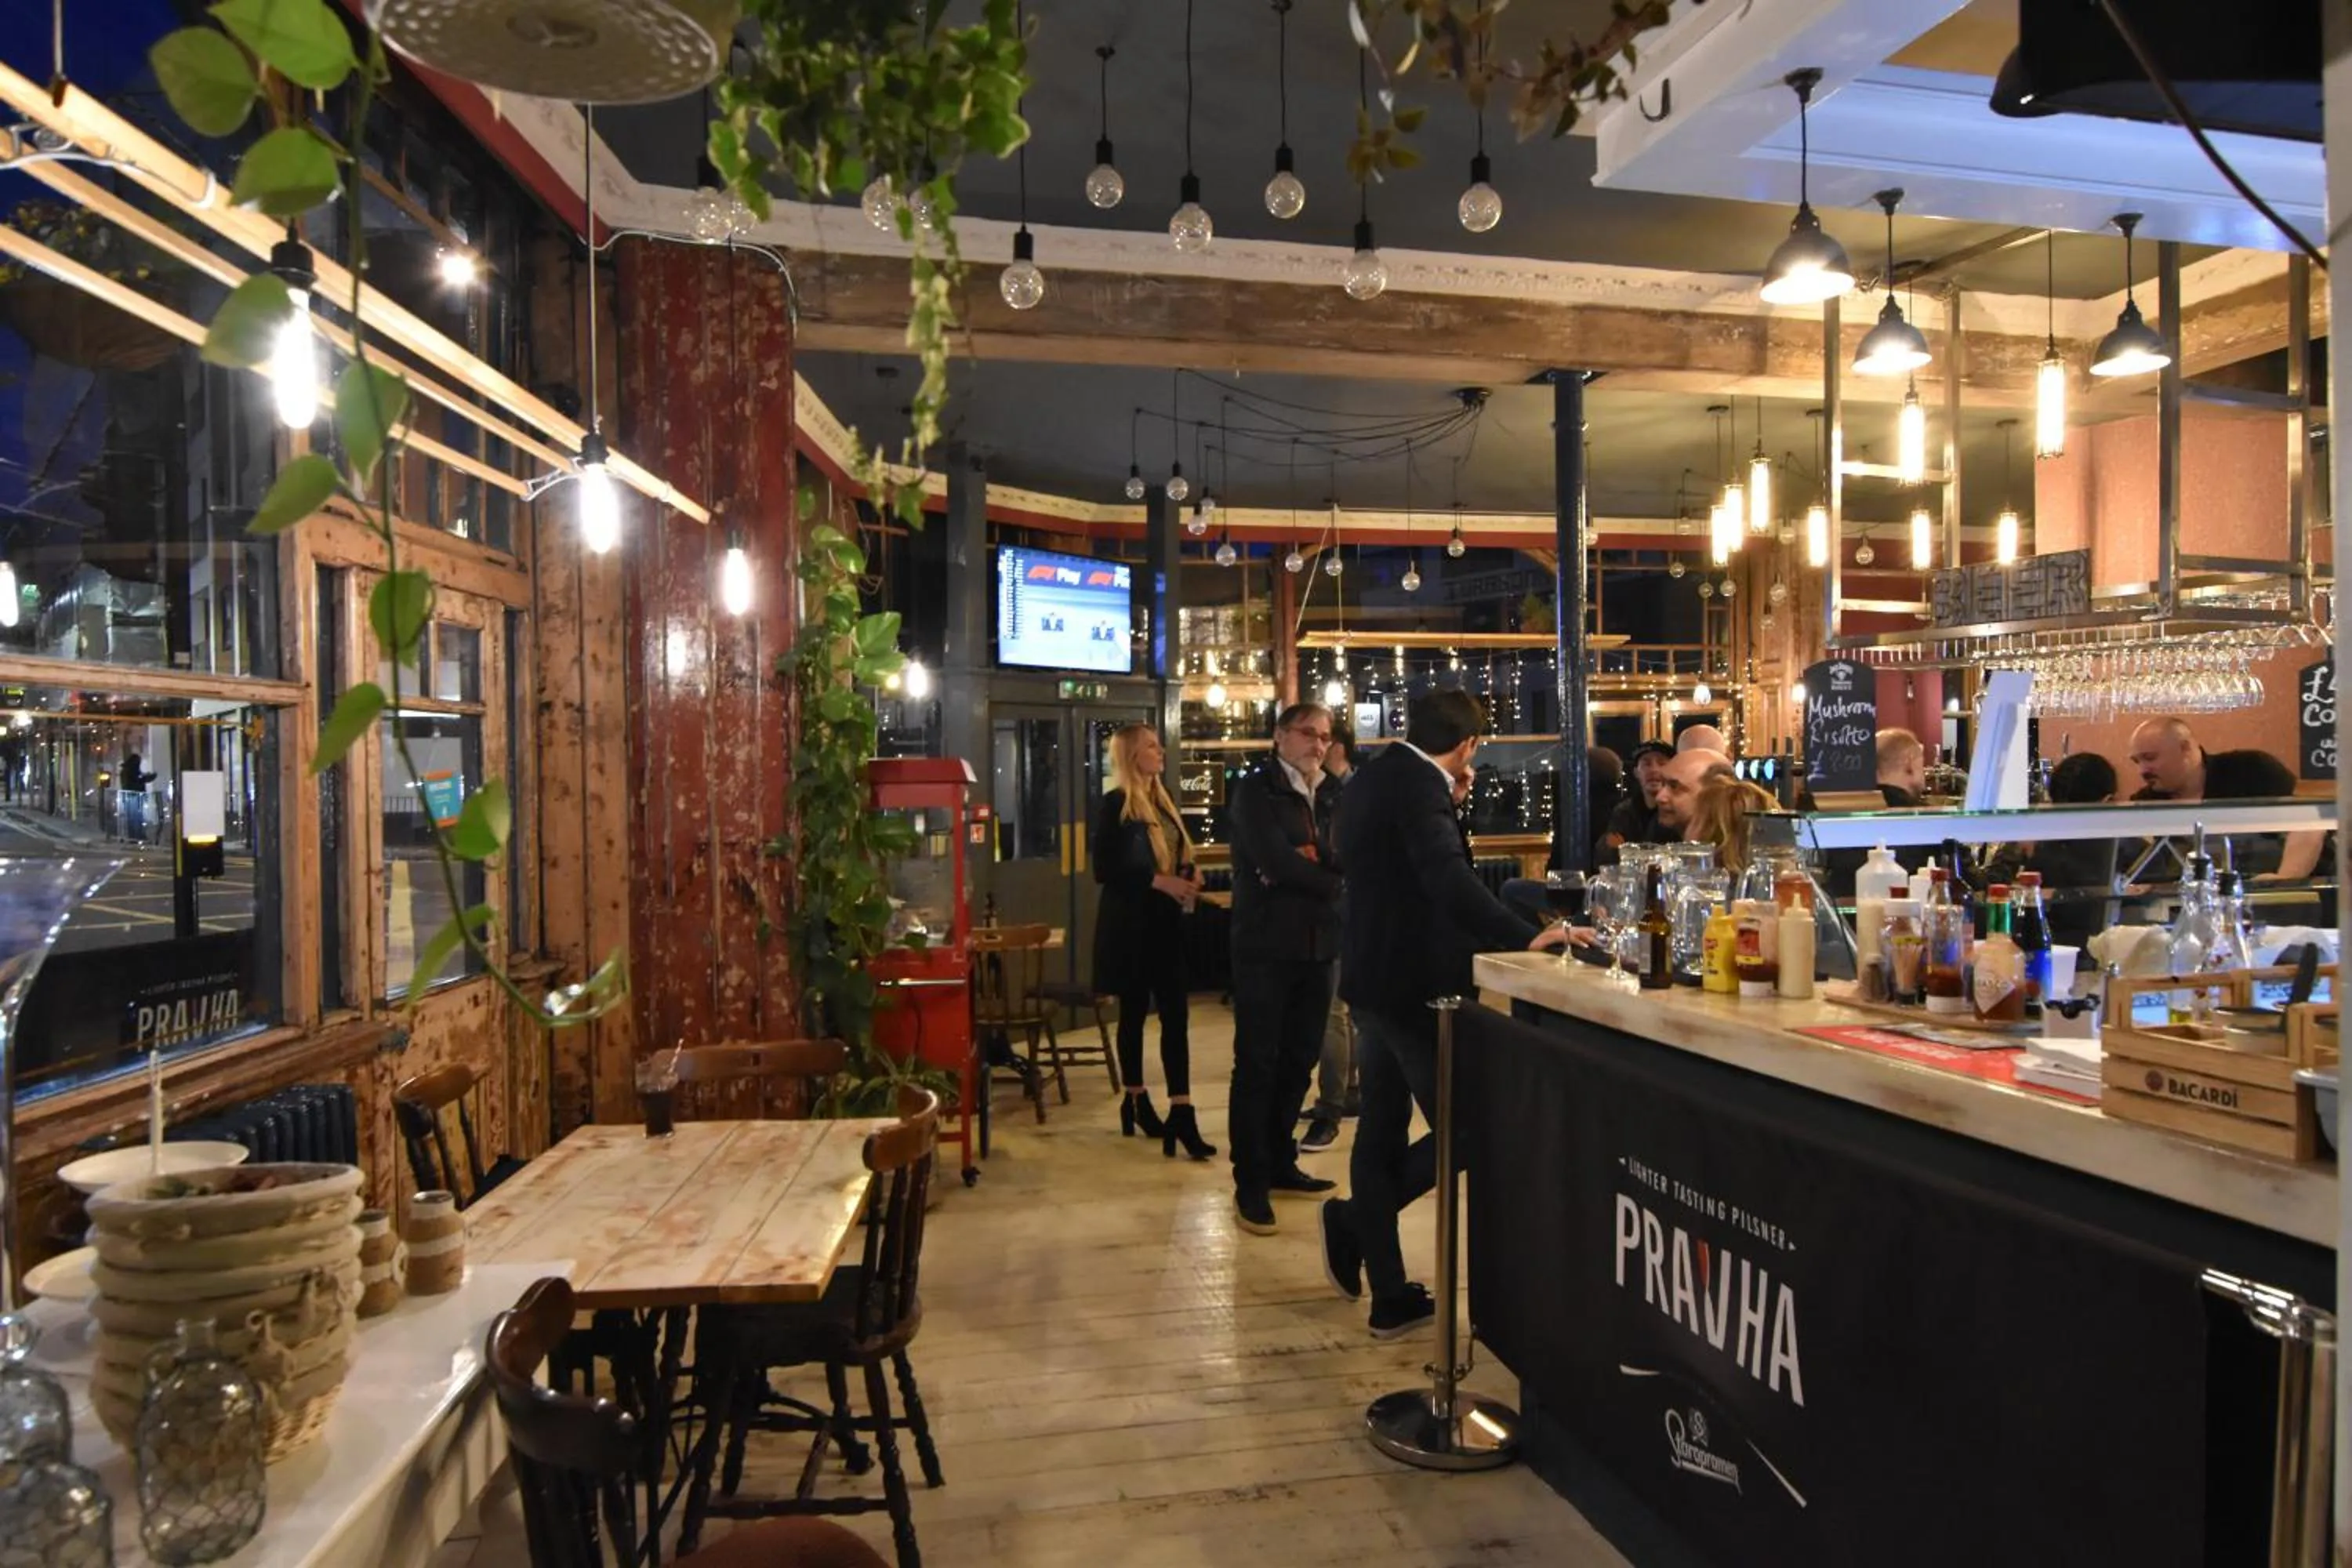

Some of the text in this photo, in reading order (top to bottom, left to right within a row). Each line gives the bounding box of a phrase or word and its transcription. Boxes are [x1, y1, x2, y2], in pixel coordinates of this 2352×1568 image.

[1935, 550, 2090, 626] BEER
[1628, 1156, 1786, 1250] LIGHTER TASTING PILSNER
[1616, 1192, 1804, 1407] PRAVHA
